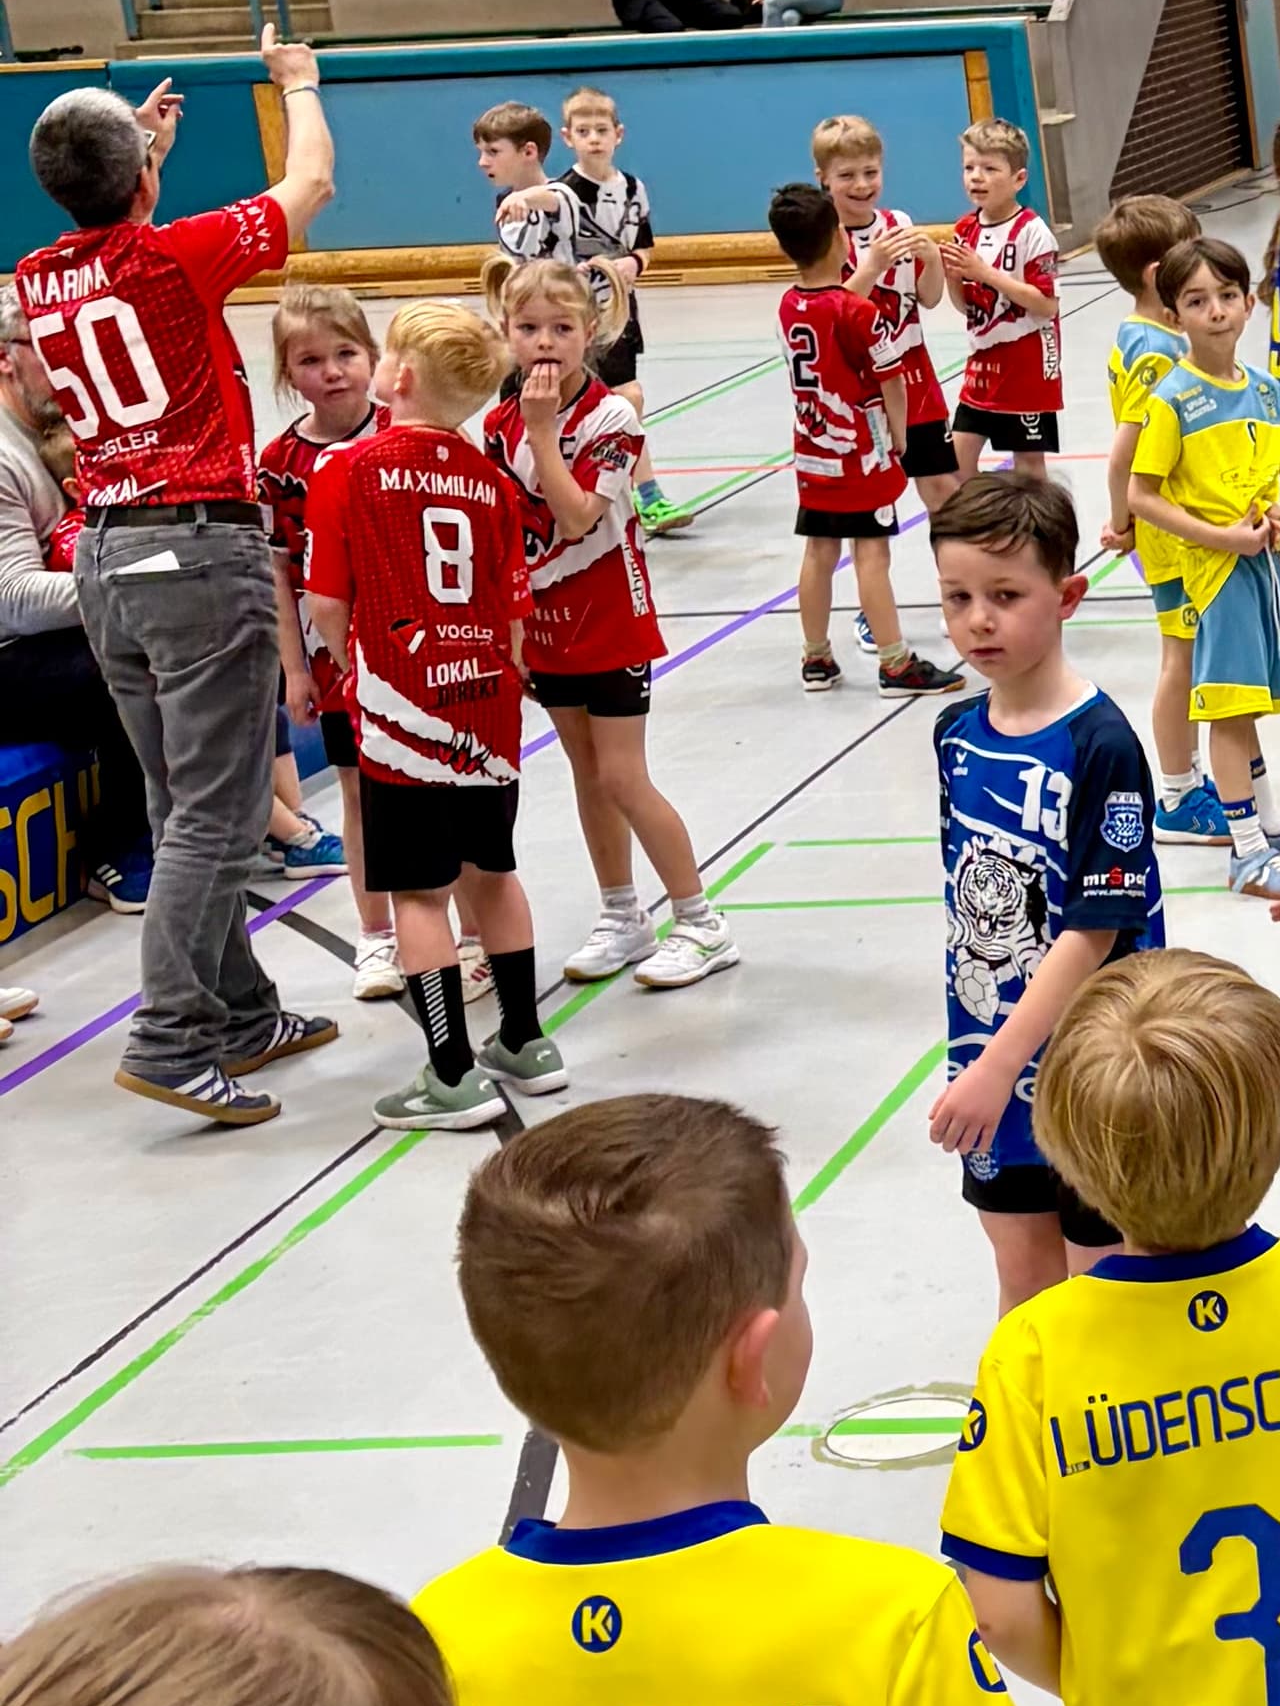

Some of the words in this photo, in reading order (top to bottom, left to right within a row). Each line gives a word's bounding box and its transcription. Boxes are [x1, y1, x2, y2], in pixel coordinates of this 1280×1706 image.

[22, 256, 112, 308] MARINA
[1002, 243, 1017, 272] 8
[29, 295, 170, 441] 50
[789, 323, 820, 390] 2
[379, 466, 496, 509] MAXIMILIAN
[421, 506, 475, 605] 8
[1017, 764, 1074, 843] 13
